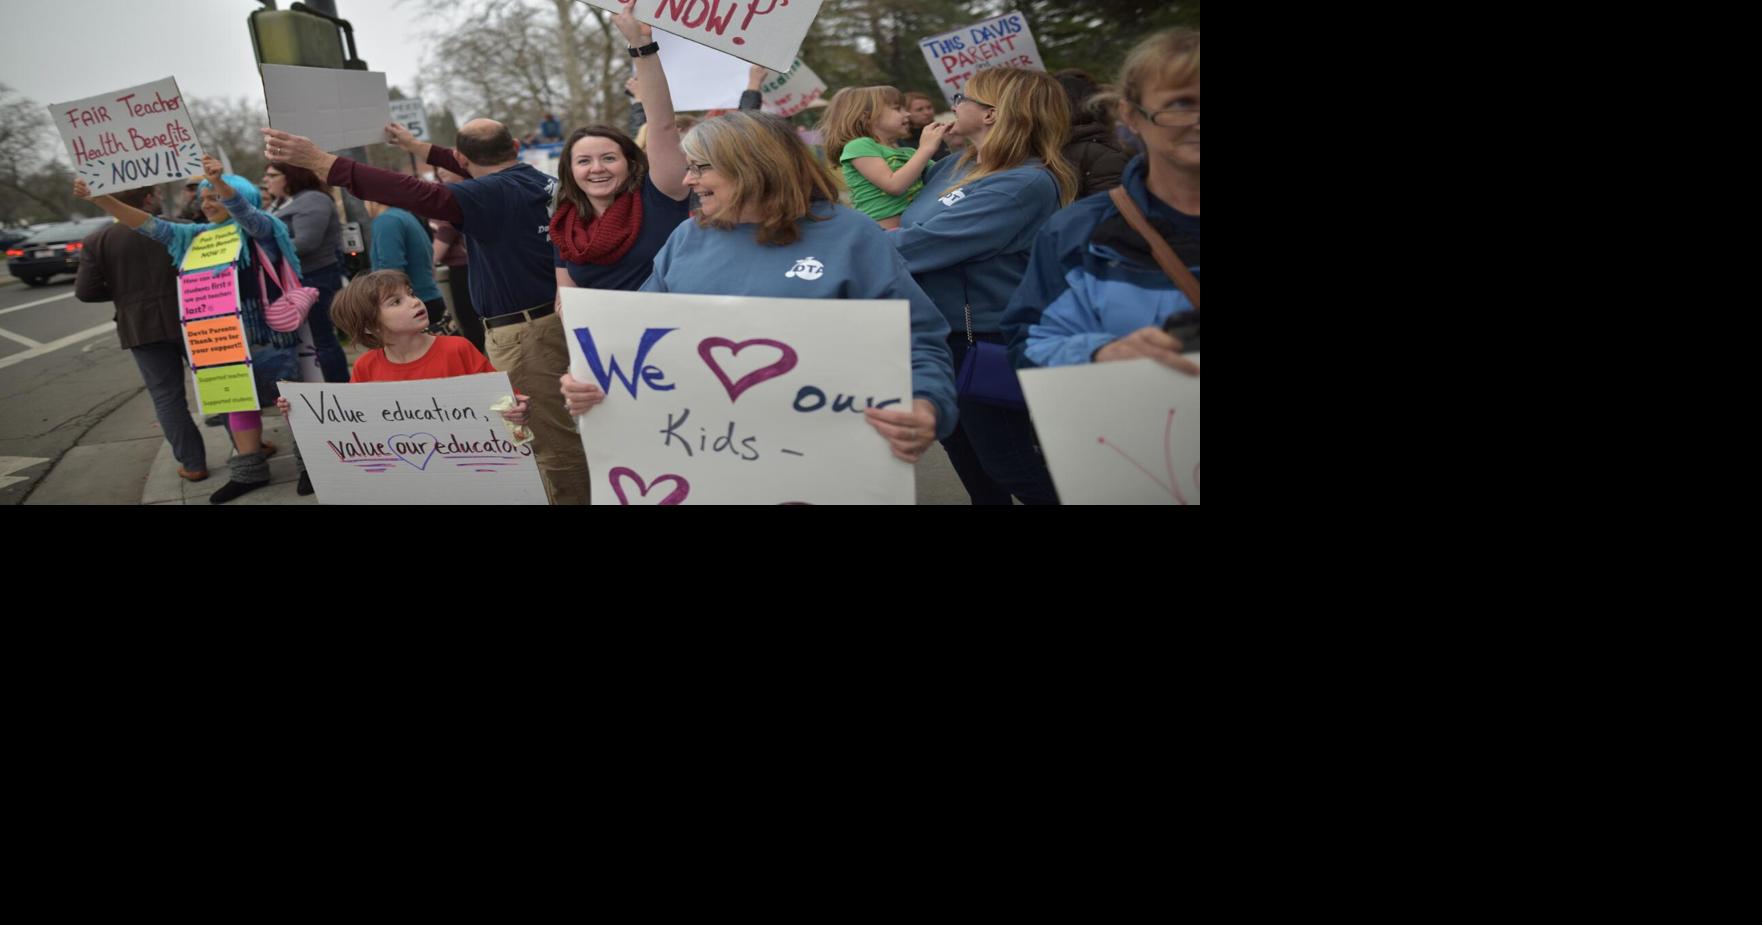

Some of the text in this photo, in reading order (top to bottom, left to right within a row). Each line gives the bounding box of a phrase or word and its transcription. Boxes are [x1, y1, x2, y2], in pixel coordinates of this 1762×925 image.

[923, 16, 1021, 58] THIS DAVIS
[941, 34, 1016, 73] PARENT
[116, 92, 180, 117] Teacher
[72, 120, 190, 165] Health Benefits
[185, 304, 207, 315] last?
[190, 338, 213, 346] Thank
[192, 347, 209, 355] your
[573, 327, 680, 401] We
[301, 390, 368, 424] Value
[326, 431, 391, 460] value
[395, 440, 434, 455] our
[659, 408, 760, 461] Kids
